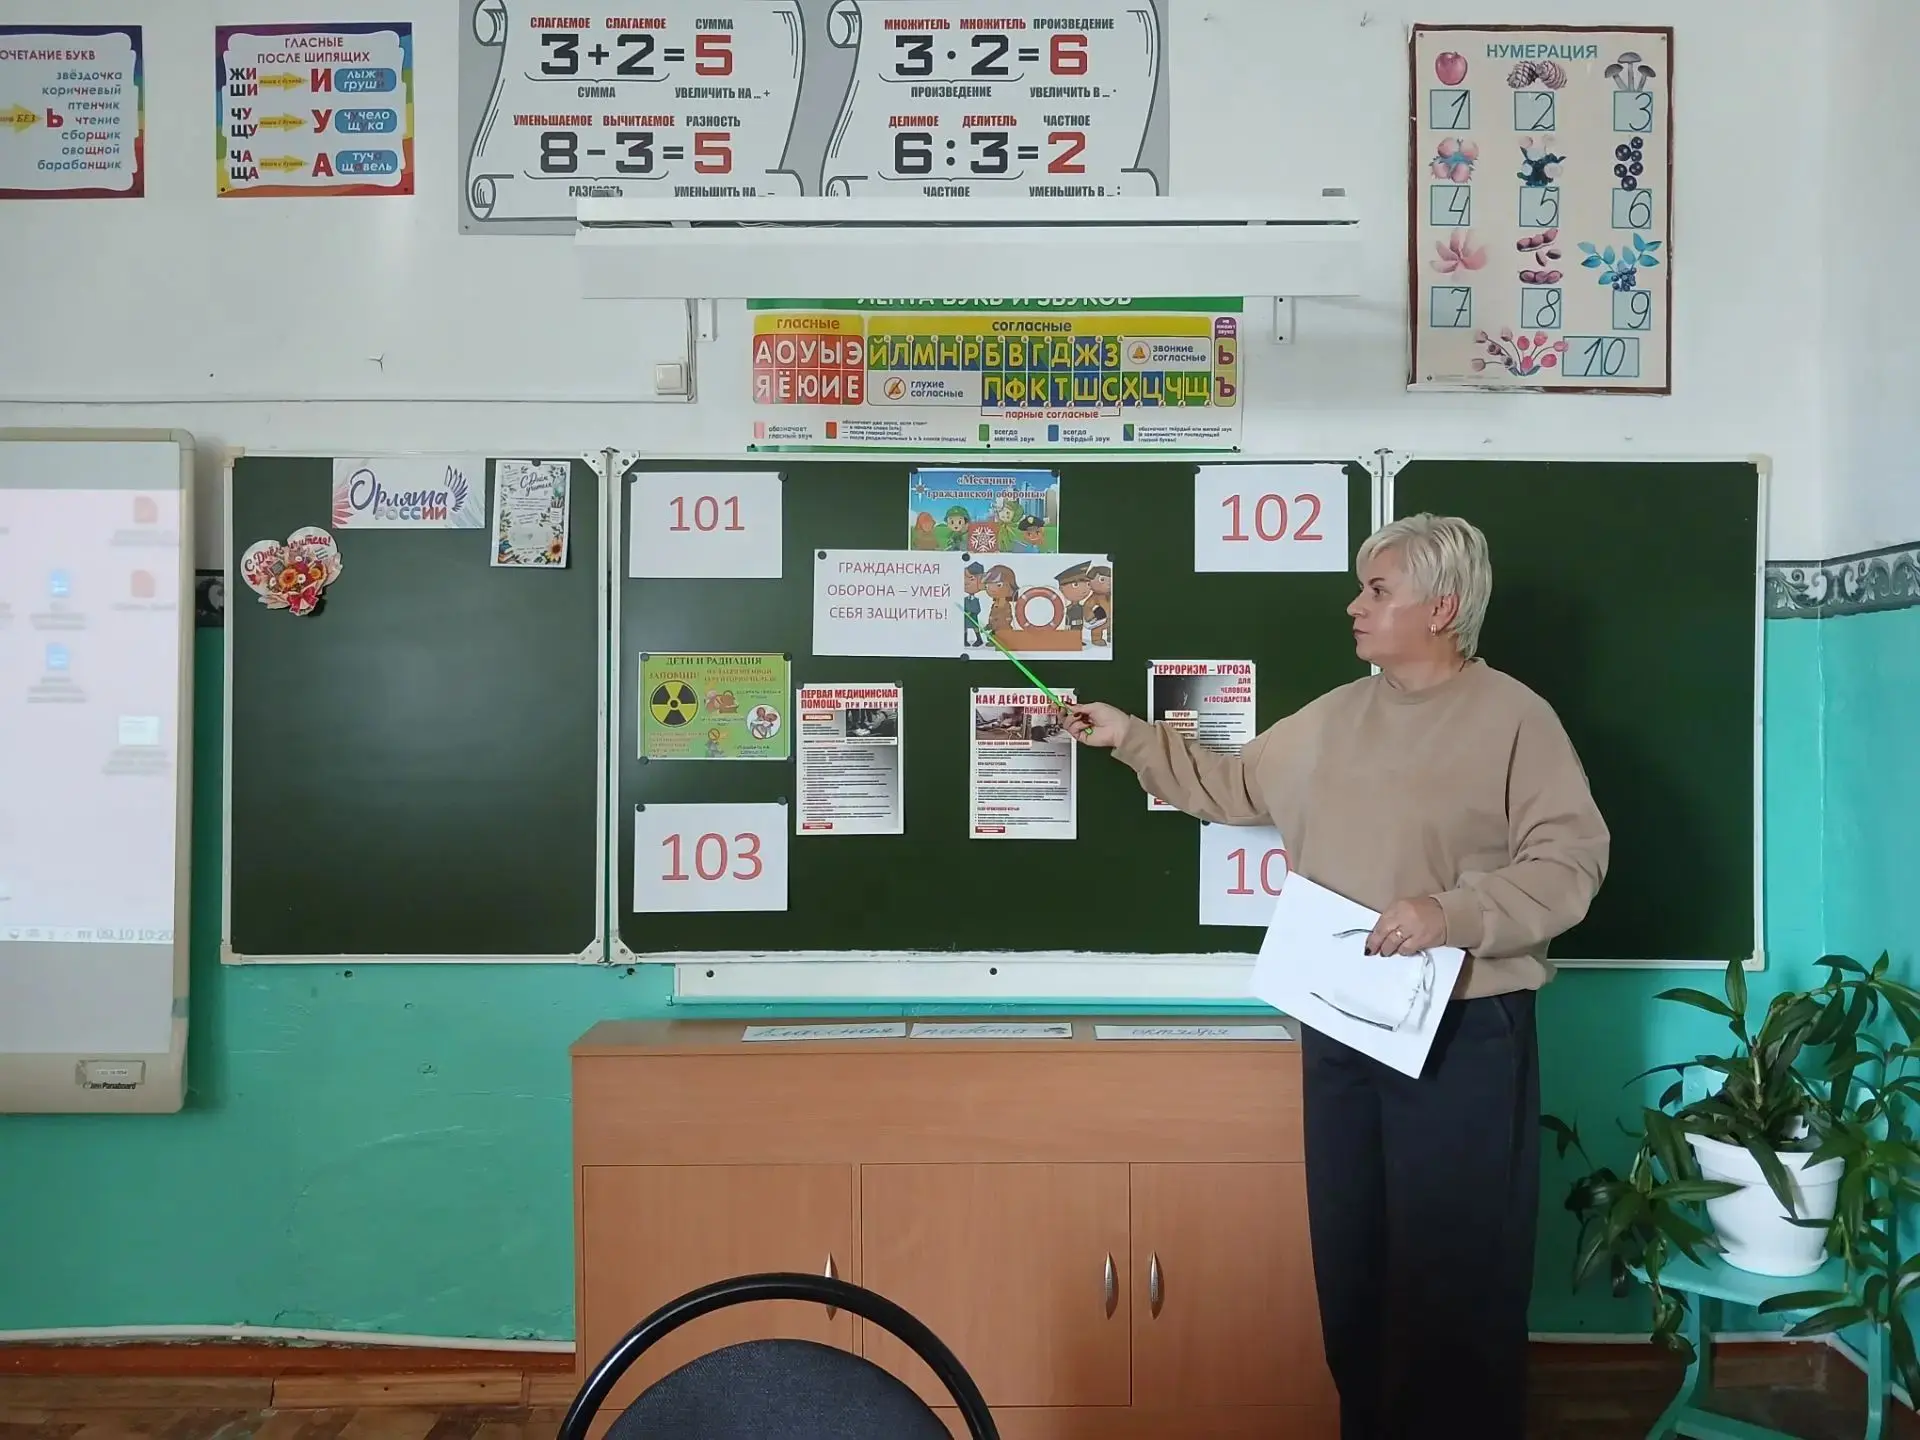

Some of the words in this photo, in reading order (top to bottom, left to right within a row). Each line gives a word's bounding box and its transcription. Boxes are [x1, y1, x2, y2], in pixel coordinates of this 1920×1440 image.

[530, 17, 590, 29] СЛАГАЕМОЕ
[605, 18, 666, 29] СЛАГАЕМОЕ
[695, 18, 733, 30] СУММА
[884, 18, 951, 30] МНОЖИТЕЛЬ
[959, 18, 1026, 30] МНОЖИТЕЛЬ
[1033, 18, 1114, 31] ПРОИЗВЕДЕНИЕ
[285, 37, 344, 48] ГЛАСНЫЕ
[66, 50, 95, 60] БУКВ
[257, 52, 300, 64] ПОСЛЕ
[304, 51, 370, 65] ШИПЯЩИХ
[1487, 44, 1598, 61] НУМЕРАЦИЯ
[56, 70, 122, 82] звёздочка
[230, 67, 257, 80] ЖИ
[311, 69, 332, 92] И
[42, 85, 121, 97] коричневый
[230, 84, 258, 97] ШИ
[577, 87, 616, 98] СУММА
[675, 87, 735, 99] УВЕЛИЧИТЬ
[738, 87, 752, 99] НА
[911, 86, 992, 99] ПРОИЗВЕДЕНИЕ
[1030, 87, 1090, 98] УВЕЛИЧИТЬ
[1093, 87, 1100, 98] В
[68, 101, 119, 111] птенчик
[1451, 90, 1469, 129] 1
[1532, 93, 1554, 130] 2
[1628, 93, 1652, 131] 3
[231, 107, 252, 120] ЧУ
[75, 117, 120, 125] чтение
[312, 109, 333, 133] У
[513, 115, 593, 126] УМЕНЬШАЕМОЕ
[602, 115, 675, 127] ВЫЧИТАЕМОЕ
[686, 116, 741, 127] РАЗНОСТЬ
[888, 115, 939, 128] ДЕЛИМОЕ
[962, 115, 1018, 127] ДЕЛИТЕЛЬ
[1043, 115, 1091, 126] ЧАСТНОЕ
[61, 130, 120, 142] сборщик
[231, 125, 258, 139] ЩУ
[61, 144, 120, 156] овощной
[231, 150, 253, 162] ЧА
[37, 159, 121, 172] барабанщик
[312, 152, 334, 177] А
[231, 167, 259, 181] ЩА
[674, 186, 740, 198] УМЕНЬШИТЬ
[742, 186, 756, 198] НА
[923, 186, 971, 197] ЧАСТНОЕ
[1029, 186, 1095, 197] УМЕНЬШИТЬ
[1097, 186, 1104, 197] В
[1449, 187, 1469, 225] 4
[1536, 187, 1559, 226] 5
[1629, 190, 1651, 228] 6
[1451, 288, 1470, 327] 7
[1536, 290, 1560, 327] 8
[1628, 291, 1650, 329] 9
[777, 319, 840, 331] гласные
[992, 320, 1072, 333] согласные
[1153, 345, 1194, 353] звонкие
[1153, 354, 1207, 363] согласные
[1584, 337, 1625, 376] 10
[911, 380, 945, 390] глухие
[911, 389, 963, 398] согласные
[1005, 411, 1043, 420] парные
[1046, 411, 1099, 419] согласные
[957, 475, 1016, 486] «Месячник
[350, 468, 448, 515] Орлята
[928, 488, 993, 499] гражданской
[996, 488, 1046, 499] обороны»
[668, 495, 745, 532] 101
[1222, 493, 1323, 541] 102
[838, 562, 941, 577] ГРАЖДАНСКАЯ
[827, 584, 896, 599] ОБОРОНА
[911, 582, 952, 598] УМЕЙ
[829, 607, 865, 620] СЕБЯ
[867, 607, 948, 622] ЗАЩИТИТЬ!
[666, 656, 694, 666] ДЕТИ
[706, 656, 761, 666] РАДИАЦИЯ
[1154, 664, 1208, 674] ТЕРРОРИЗМ
[1217, 664, 1251, 674] УГРОЗА
[801, 689, 832, 699] ПЕРВАЯ
[835, 689, 899, 700] МЕДИЦИНСКАЯ
[976, 695, 995, 704] КАК
[998, 693, 1073, 705] ДЕЙСТВОВТЬ
[801, 699, 841, 709] ПОМОЩЬ
[661, 833, 762, 881] 103
[1227, 848, 1291, 896] 10
